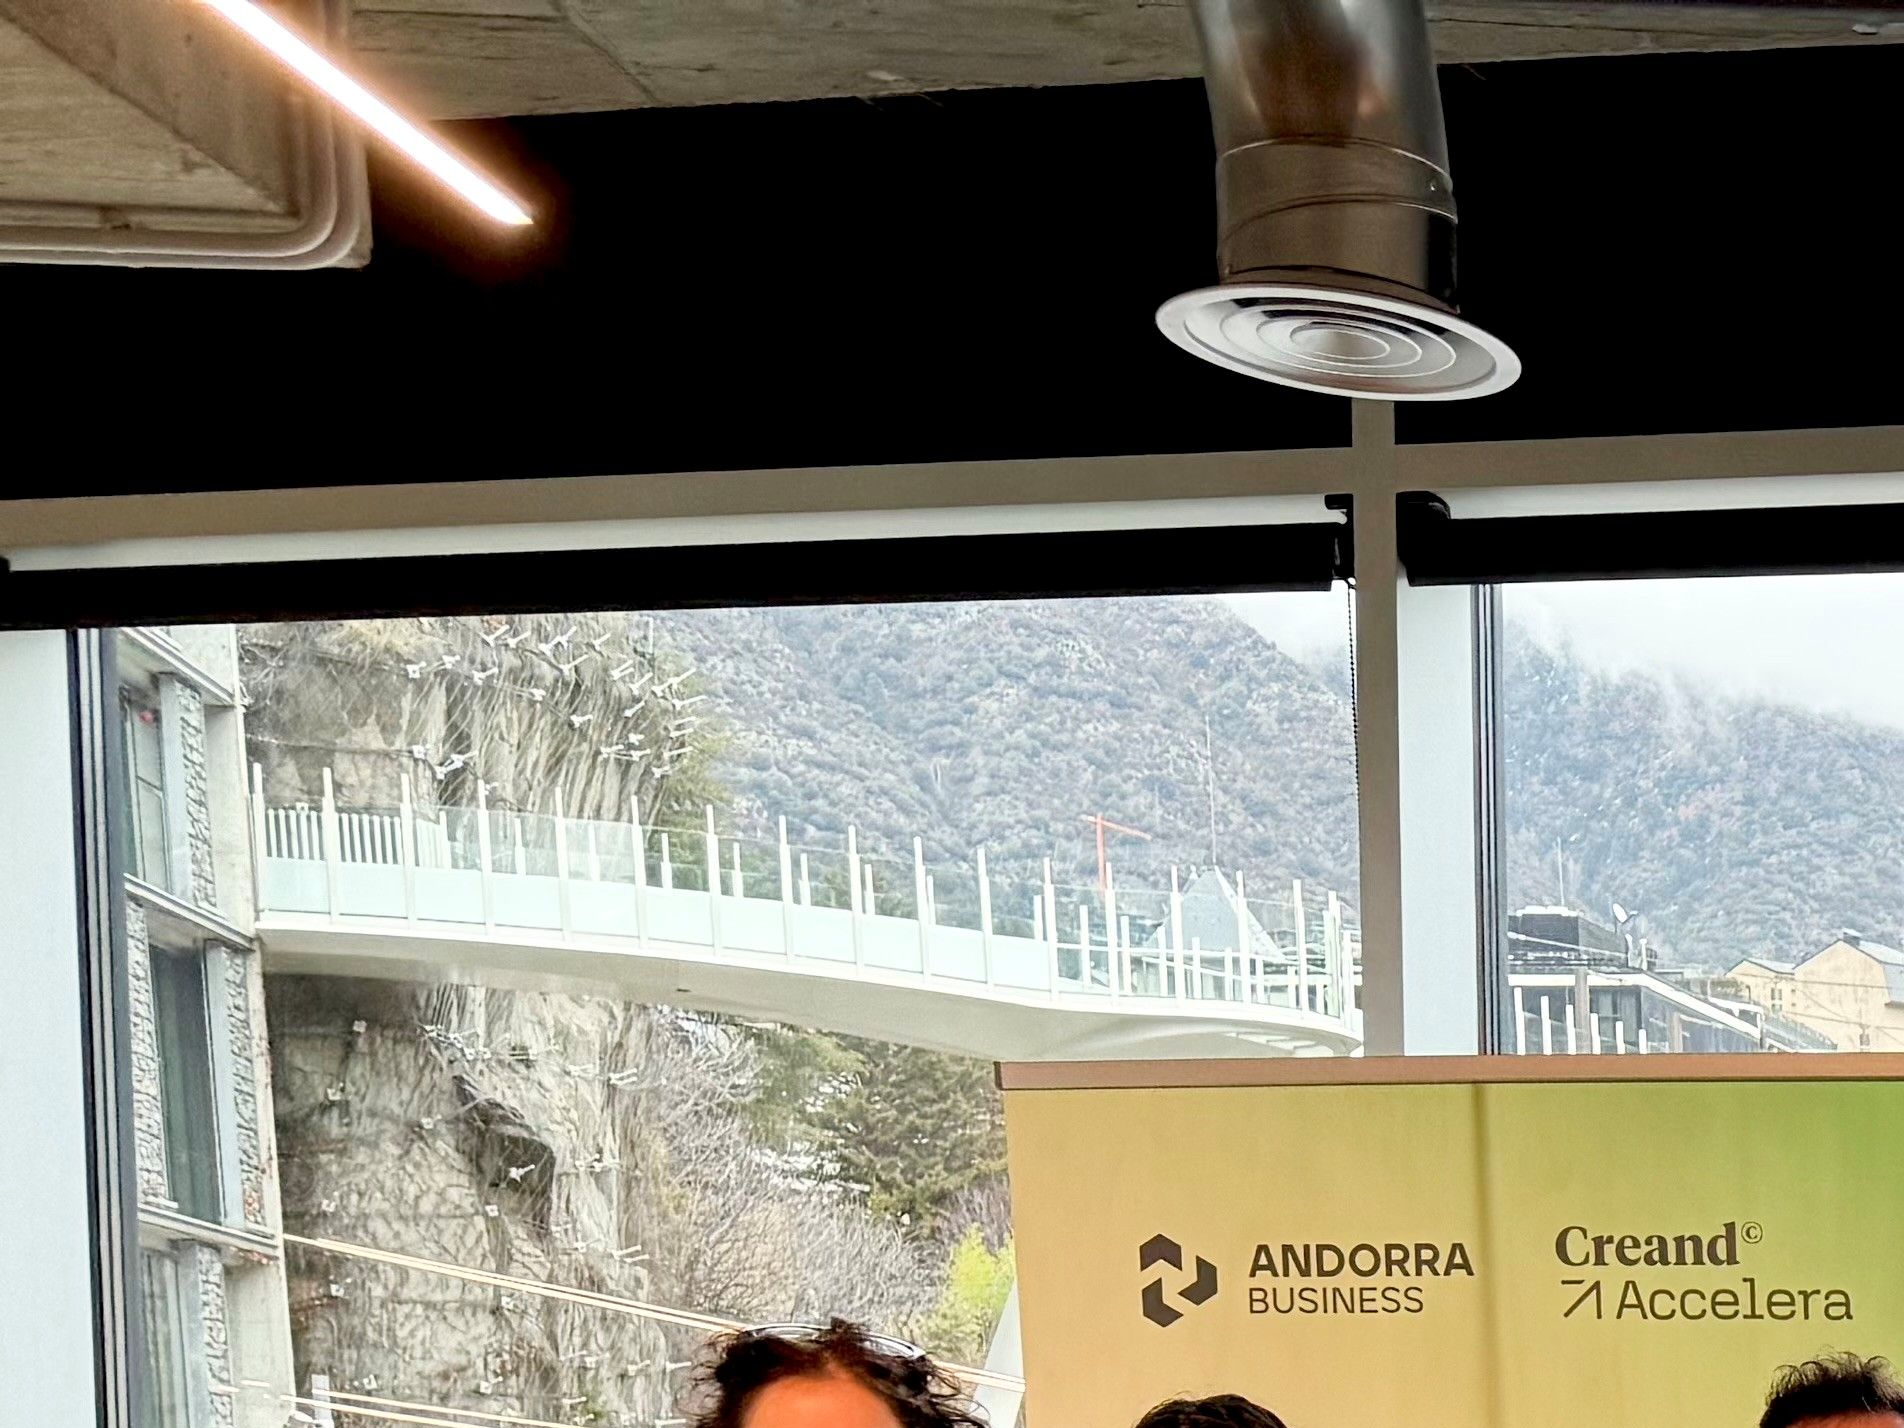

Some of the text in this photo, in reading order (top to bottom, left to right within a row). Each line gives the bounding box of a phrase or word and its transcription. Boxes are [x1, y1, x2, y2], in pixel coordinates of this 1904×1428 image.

[1247, 1242, 1475, 1279] ANDORRA
[1248, 1286, 1426, 1315] BUSINESS
[1615, 1277, 1854, 1322] Accelera
